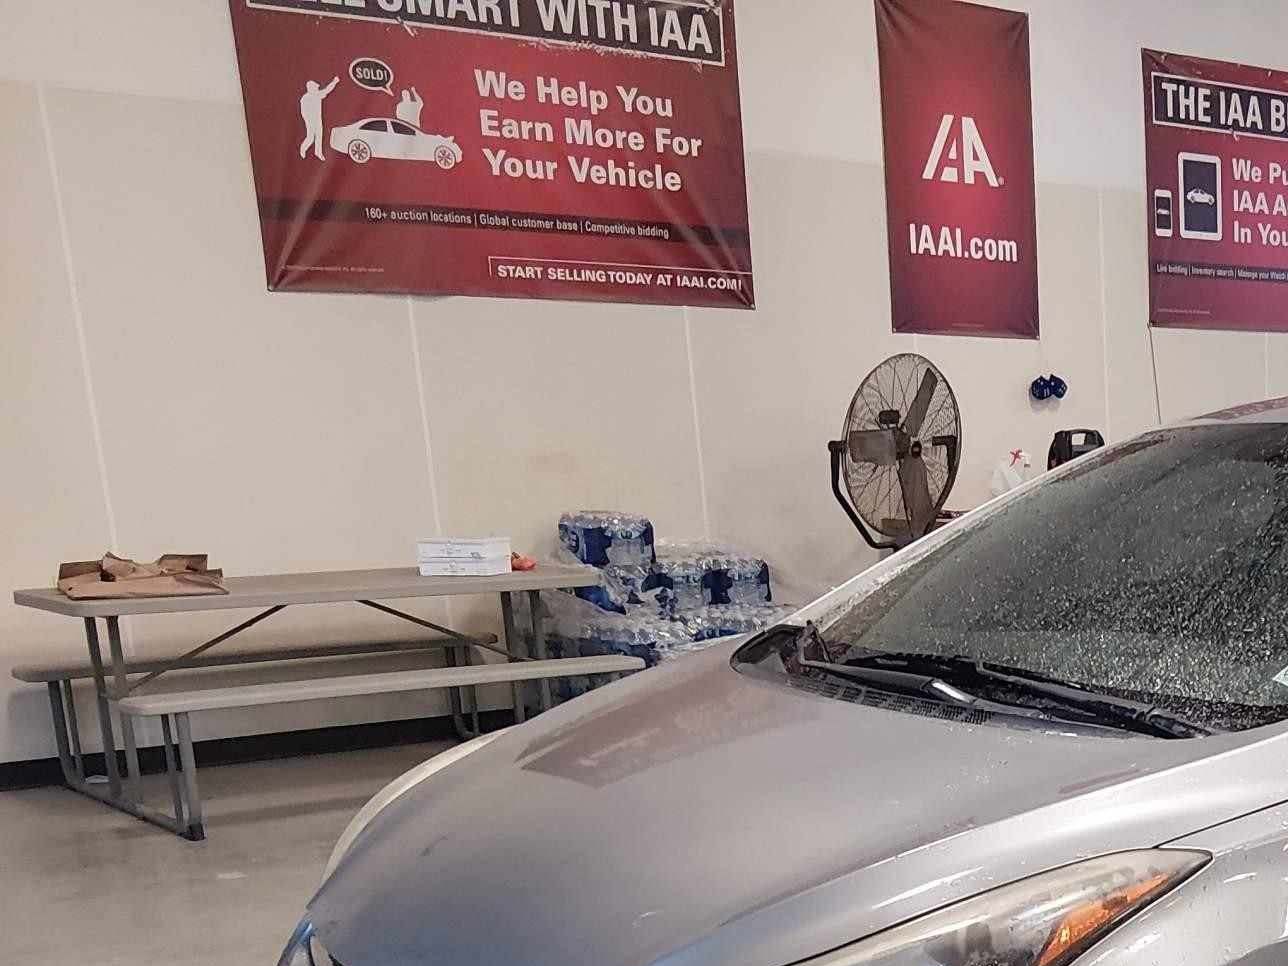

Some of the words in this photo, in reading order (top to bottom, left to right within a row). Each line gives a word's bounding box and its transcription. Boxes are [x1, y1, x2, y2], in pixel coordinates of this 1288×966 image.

[536, 0, 638, 43] WITH
[648, 7, 714, 53] IAA
[355, 67, 388, 81] SOLD!
[474, 69, 526, 101] We
[536, 76, 608, 115] Help
[616, 85, 673, 117] You
[1161, 82, 1212, 123] THE
[1219, 90, 1263, 130] IAA
[479, 109, 554, 142] Earn
[564, 118, 645, 151] More
[655, 127, 702, 157] For
[482, 148, 558, 180] Your
[567, 155, 682, 191] Vehicle
[1232, 158, 1262, 183] We
[1233, 190, 1269, 215] IAA
[365, 207, 388, 220] 160+
[390, 209, 428, 221] auction
[430, 211, 472, 224] locations
[479, 213, 509, 226] Global
[512, 217, 554, 229] customer
[556, 220, 578, 231] base
[585, 220, 636, 235] Competitive
[637, 224, 670, 240] bidding
[1233, 221, 1251, 244] In
[909, 223, 1018, 262] IAAI.com
[497, 265, 544, 279] START
[547, 268, 606, 282] SELLING
[608, 271, 652, 285] TODAY
[656, 274, 673, 287] AT
[676, 275, 743, 291] IAAI.COM!
